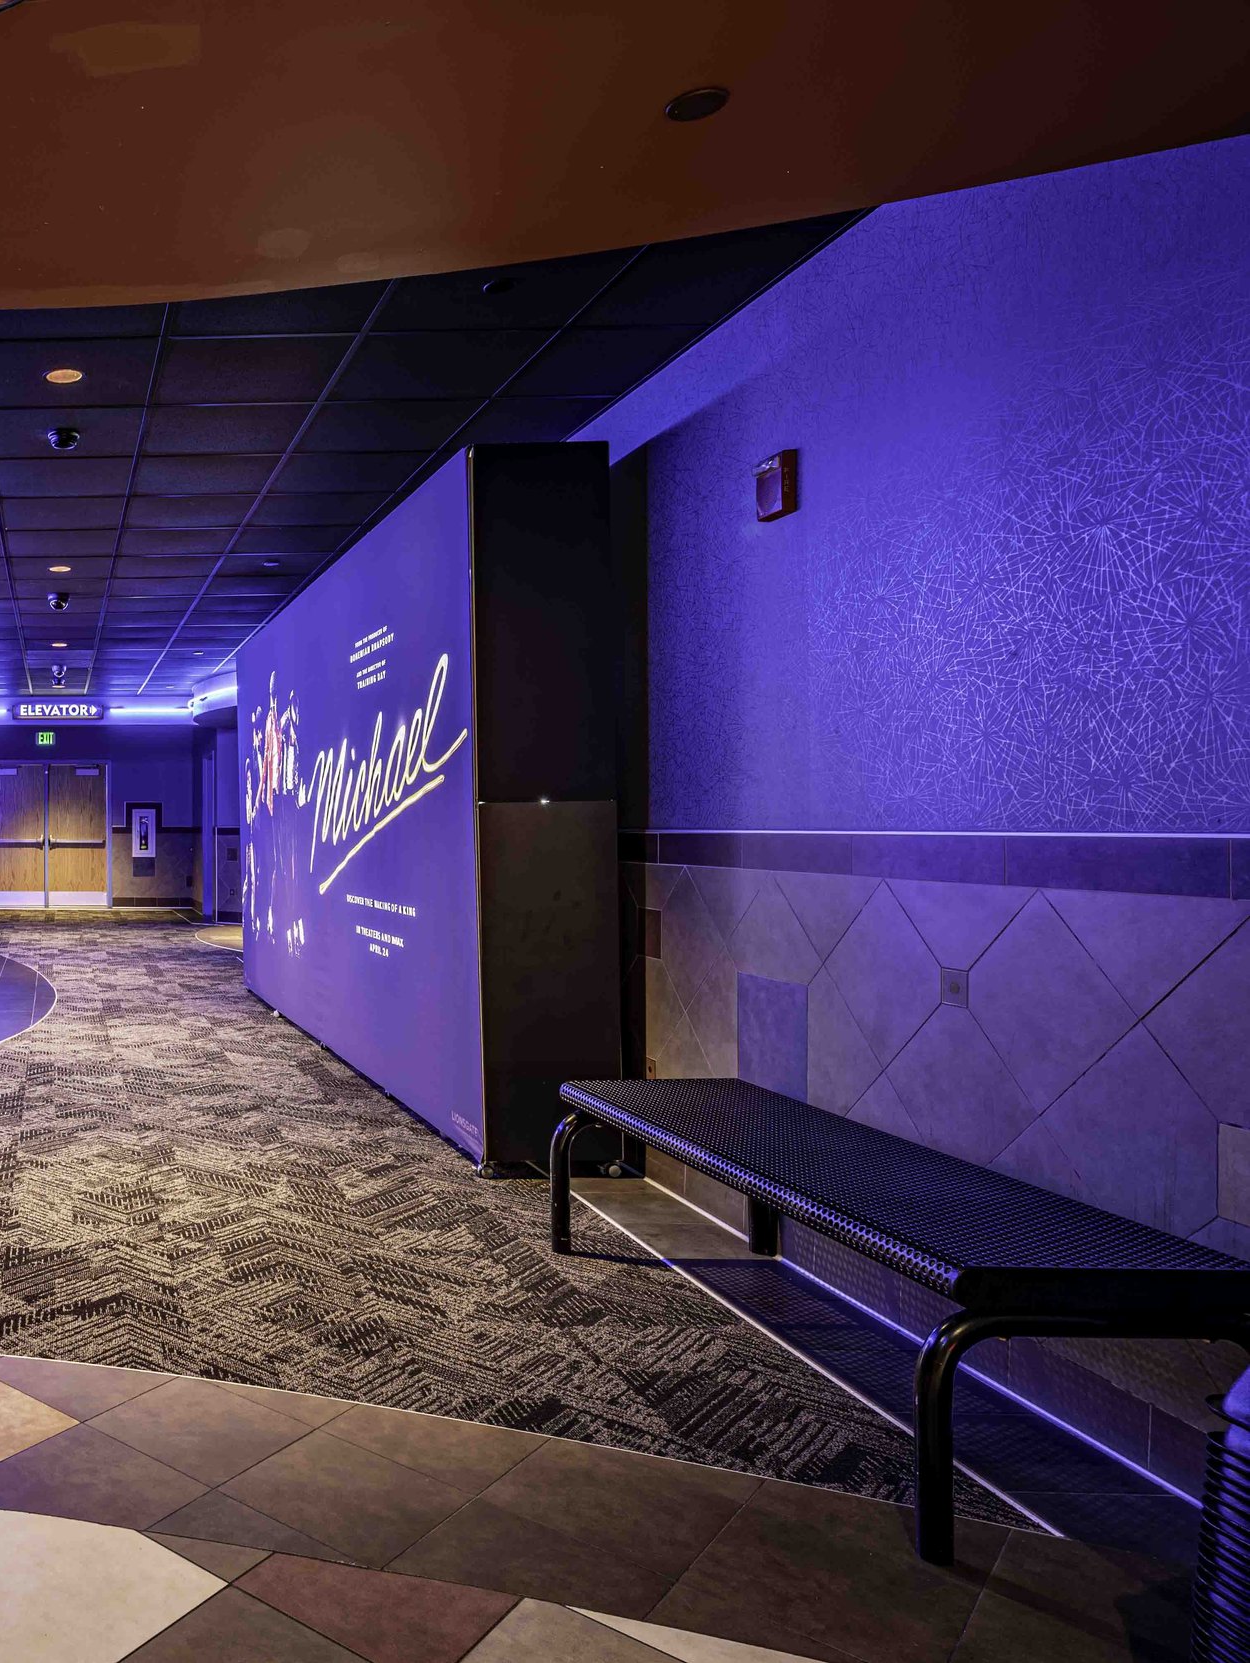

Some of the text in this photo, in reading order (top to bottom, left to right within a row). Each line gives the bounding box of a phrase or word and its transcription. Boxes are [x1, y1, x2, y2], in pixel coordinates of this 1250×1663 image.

[350, 632, 395, 664] BOHEMIAN RHAPSODY
[356, 670, 387, 690] TRAINING DAY
[19, 704, 89, 716] ELEVATOR
[37, 731, 55, 745] EXIT
[307, 652, 469, 873] Michael
[346, 893, 416, 917] DISCOVER THE MAKING OF A KING
[355, 925, 361, 934] IN
[360, 926, 381, 941] THEATERS
[381, 932, 391, 944] AND
[369, 943, 389, 957] APRIL 24
[451, 1110, 479, 1137] LIONSGATE
